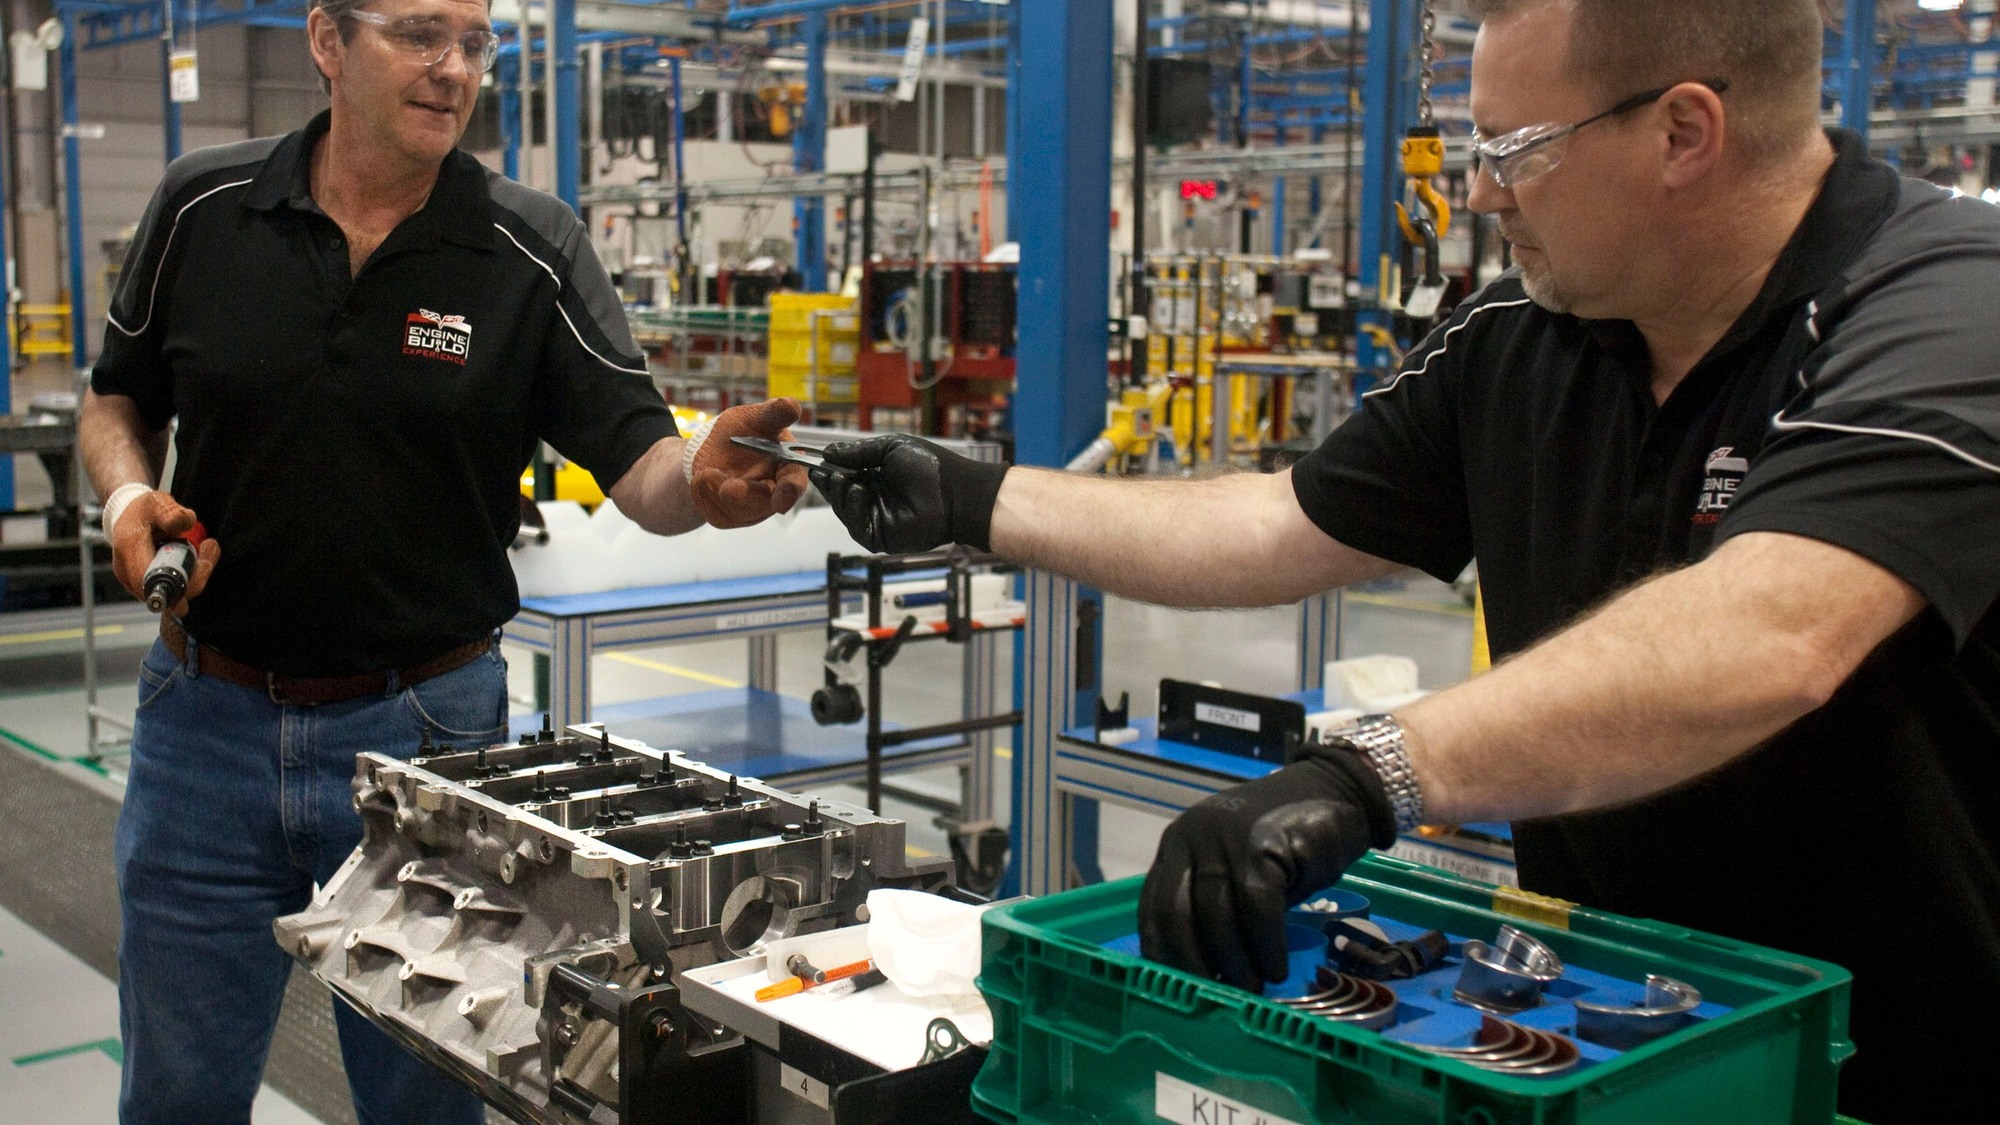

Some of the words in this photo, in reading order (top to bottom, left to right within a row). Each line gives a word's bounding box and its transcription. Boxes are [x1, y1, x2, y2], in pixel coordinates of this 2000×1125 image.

[407, 335, 465, 355] BUILD
[409, 326, 467, 346] ENGINE
[402, 346, 467, 366] EXPERIENCE
[1207, 708, 1247, 726] FRONT
[800, 1077, 808, 1095] 4
[1192, 1091, 1240, 1125] KIT
